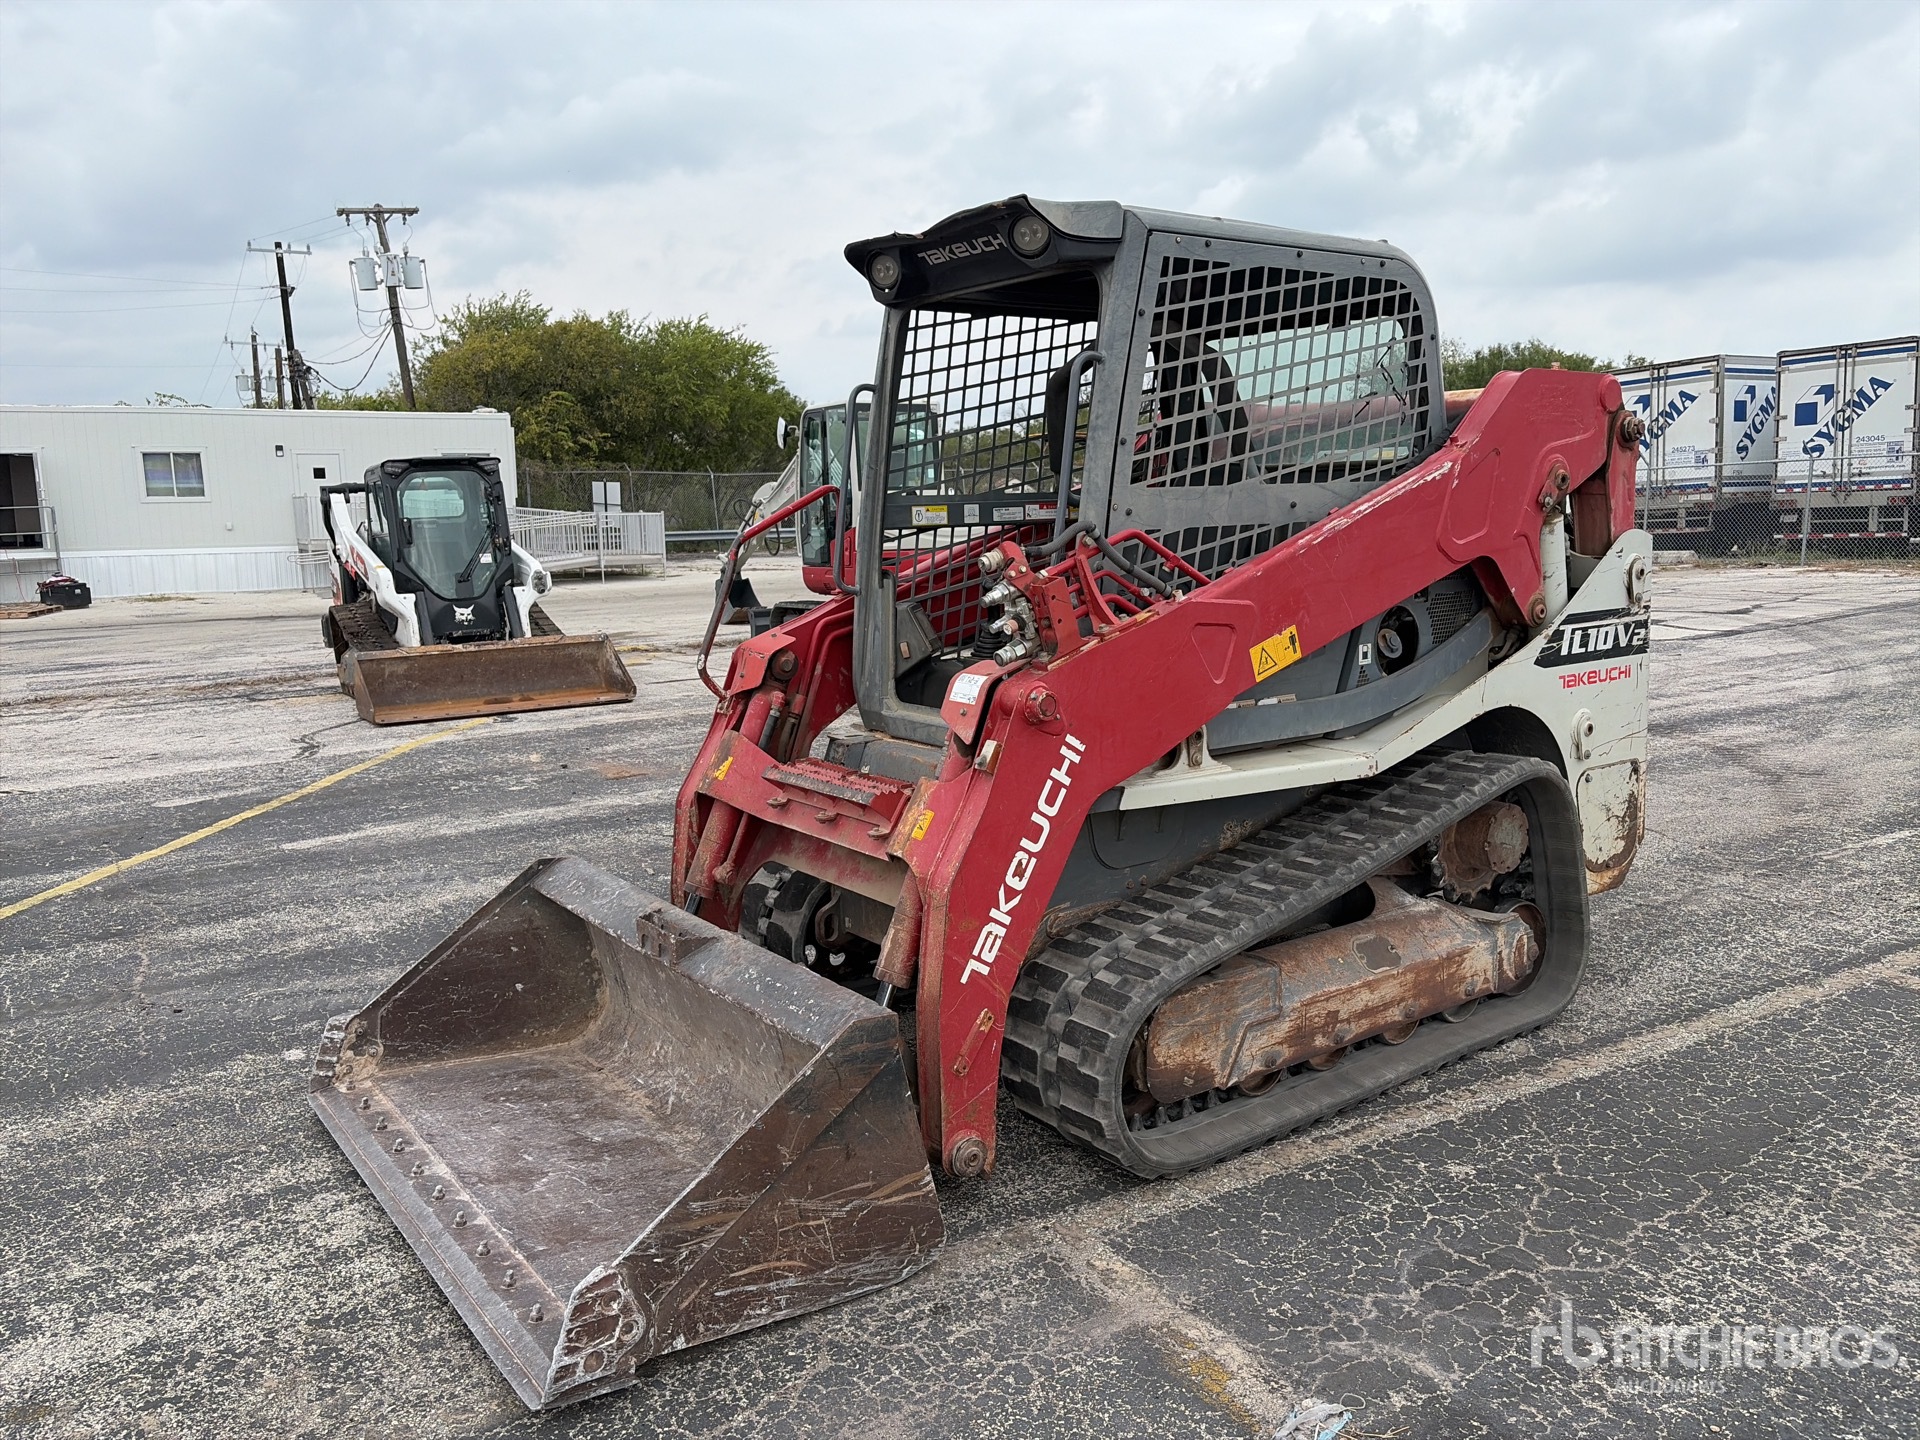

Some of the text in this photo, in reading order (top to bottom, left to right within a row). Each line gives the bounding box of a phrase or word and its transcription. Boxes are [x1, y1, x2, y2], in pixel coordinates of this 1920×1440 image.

[917, 233, 1007, 266] TAKEUCH
[1639, 390, 1699, 452] YGMA
[1802, 376, 1894, 459] SYGMA
[1671, 445, 1696, 453] 245273
[1856, 435, 1886, 443] 243045
[1558, 664, 1632, 690] TAKEUCHI
[959, 733, 1087, 985] TAKEUCHI
